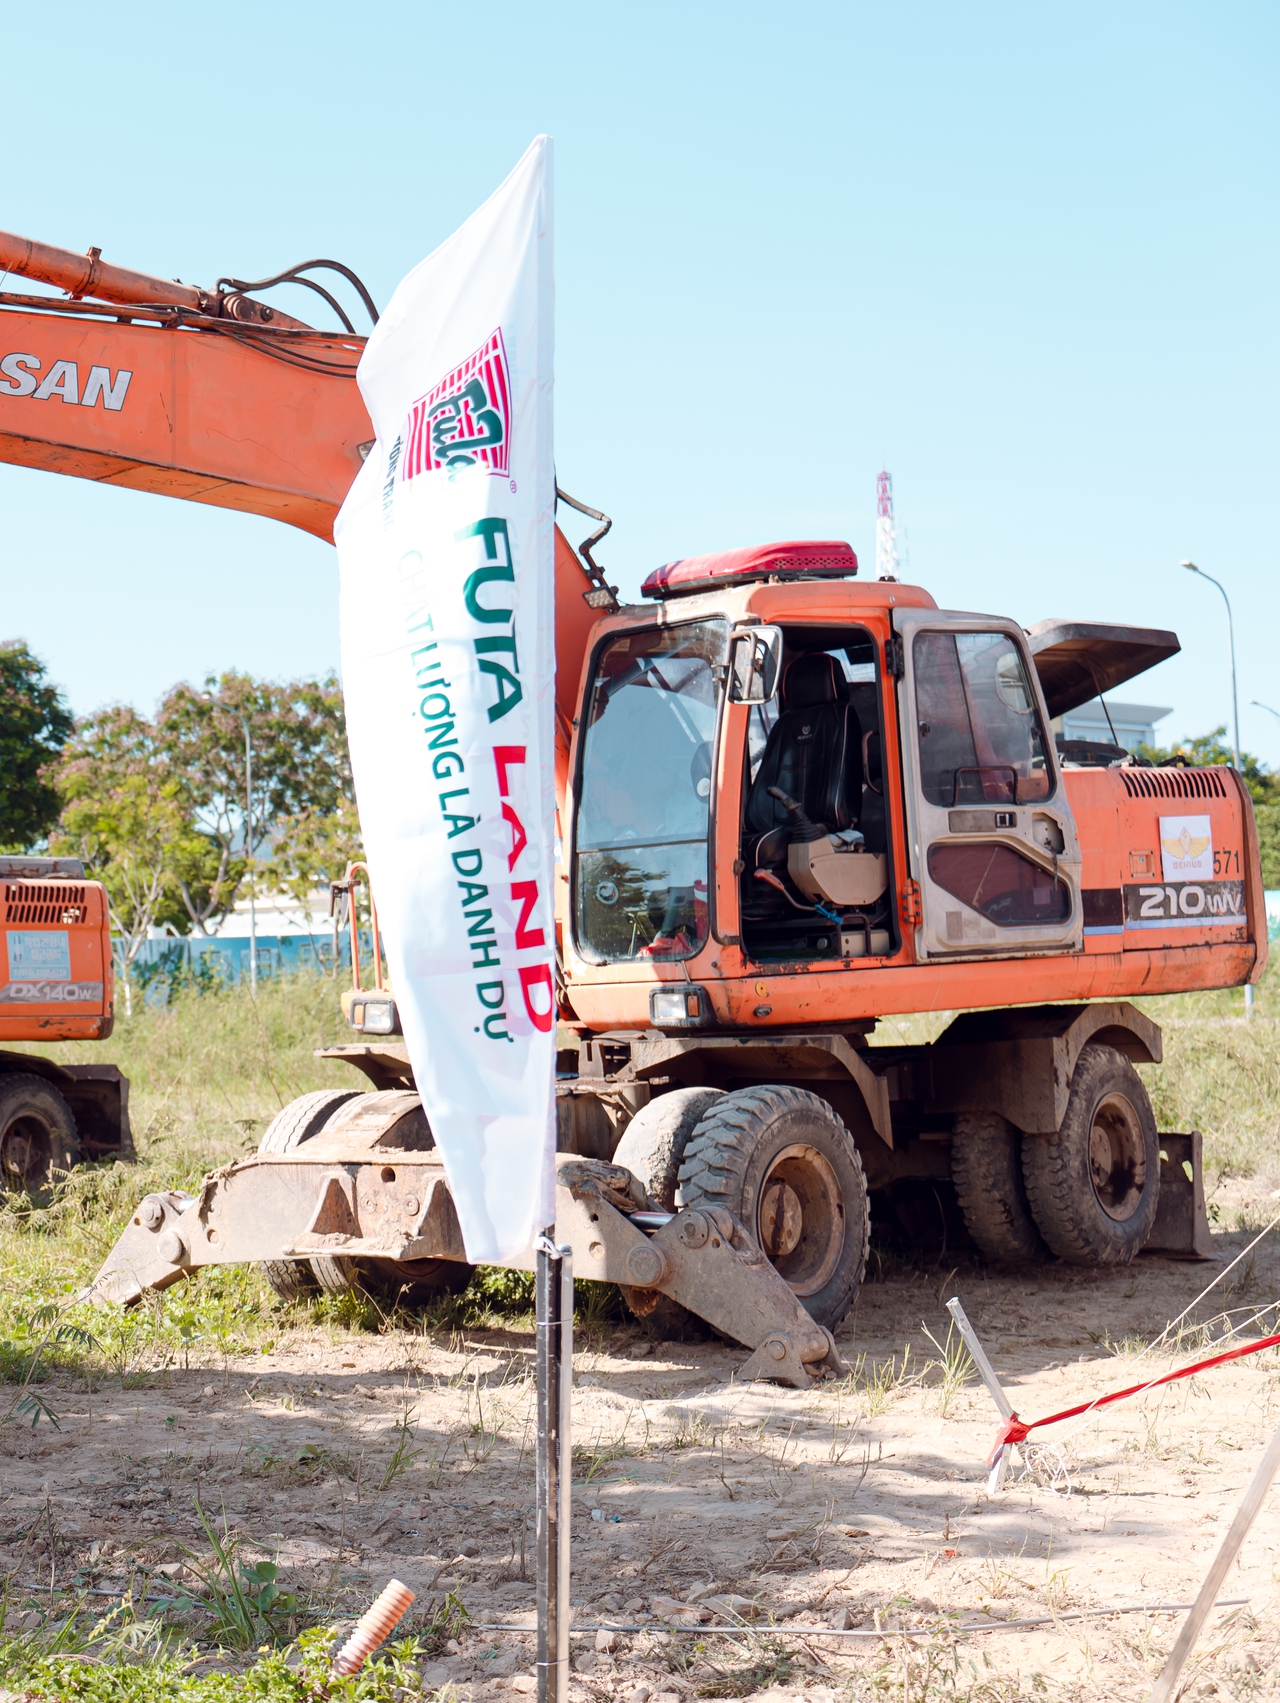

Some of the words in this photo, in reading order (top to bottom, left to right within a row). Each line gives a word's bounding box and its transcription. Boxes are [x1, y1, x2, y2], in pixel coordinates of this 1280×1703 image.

[411, 642, 464, 780] LƯỢNG
[438, 787, 481, 840] LÀ
[454, 517, 523, 724] FUTA
[492, 745, 553, 1033] LAND
[451, 848, 501, 969] DANH
[1172, 860, 1203, 870] GENIUS
[473, 980, 514, 1043] DỰ
